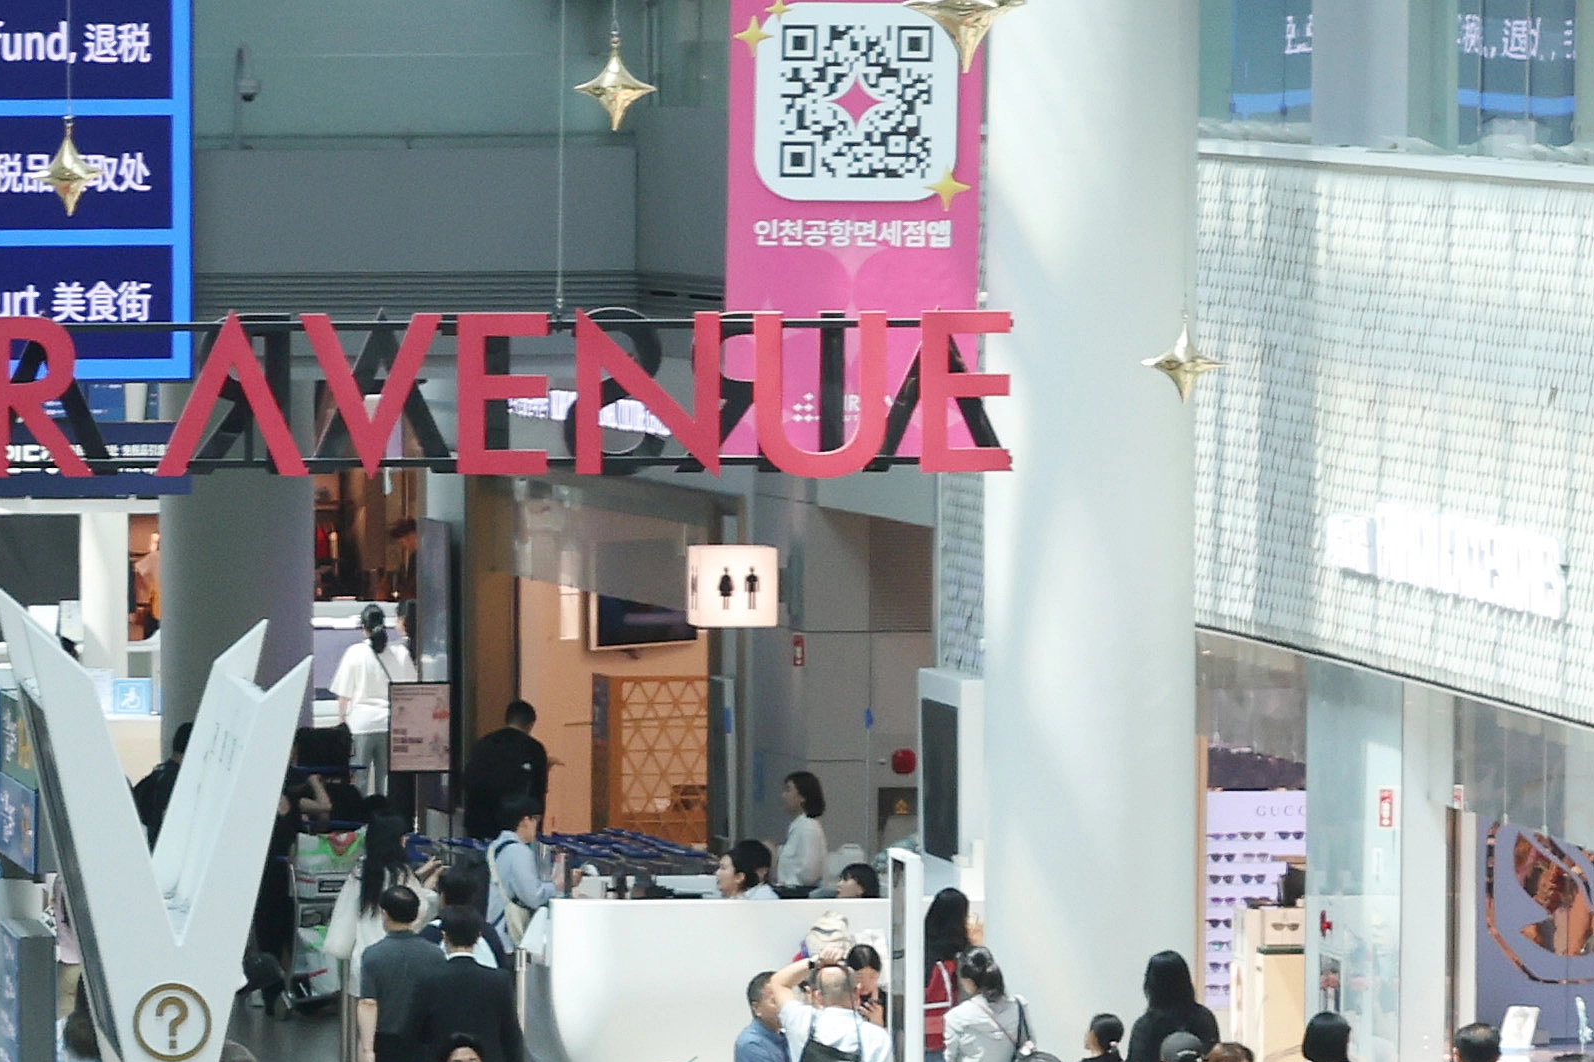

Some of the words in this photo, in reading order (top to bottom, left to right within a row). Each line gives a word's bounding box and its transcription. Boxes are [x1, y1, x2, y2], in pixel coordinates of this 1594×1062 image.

[83, 22, 152, 63] 退税
[752, 218, 954, 250] 인천공항면세점앱
[51, 281, 152, 323] 美食街
[156, 309, 1012, 480] AVENUE
[1256, 804, 1307, 818] GUCC
